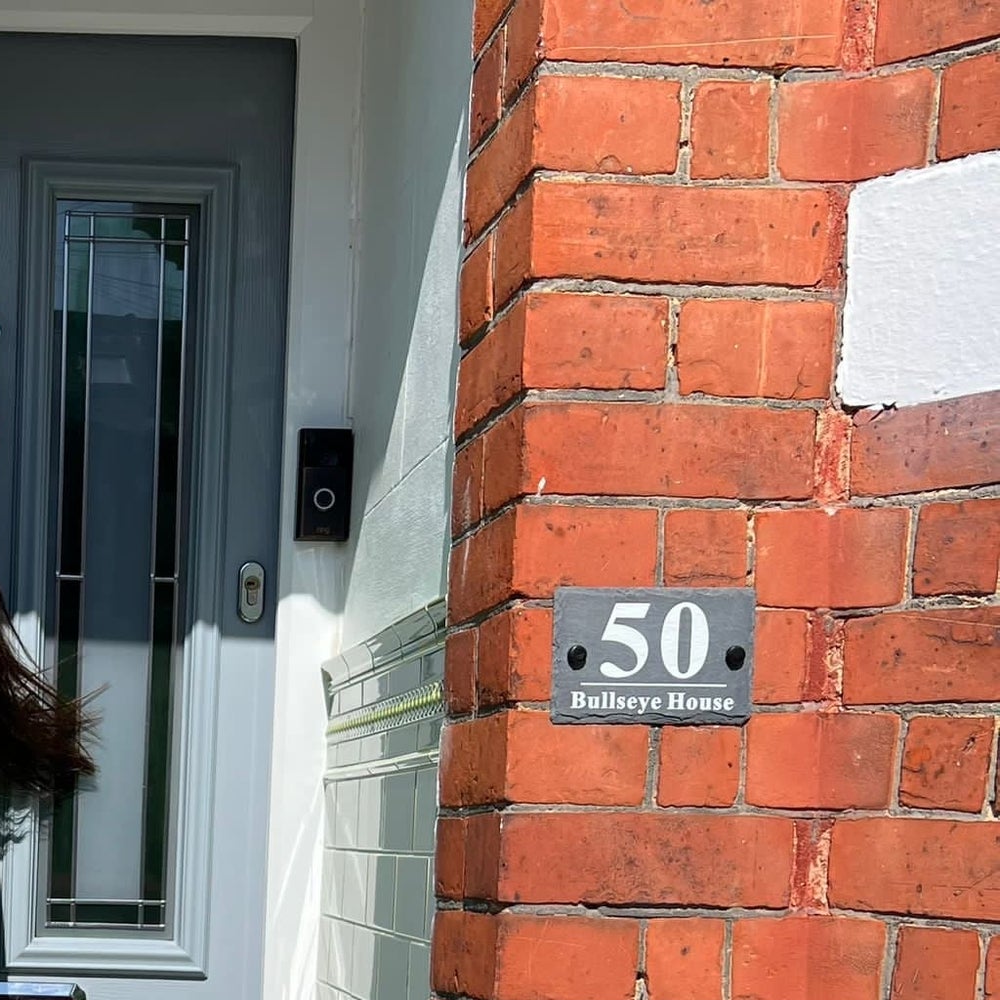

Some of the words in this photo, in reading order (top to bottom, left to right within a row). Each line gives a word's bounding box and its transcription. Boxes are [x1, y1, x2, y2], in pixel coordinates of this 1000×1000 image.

[600, 601, 710, 680] 50
[570, 691, 662, 714] Bullseye
[666, 692, 735, 711] House
